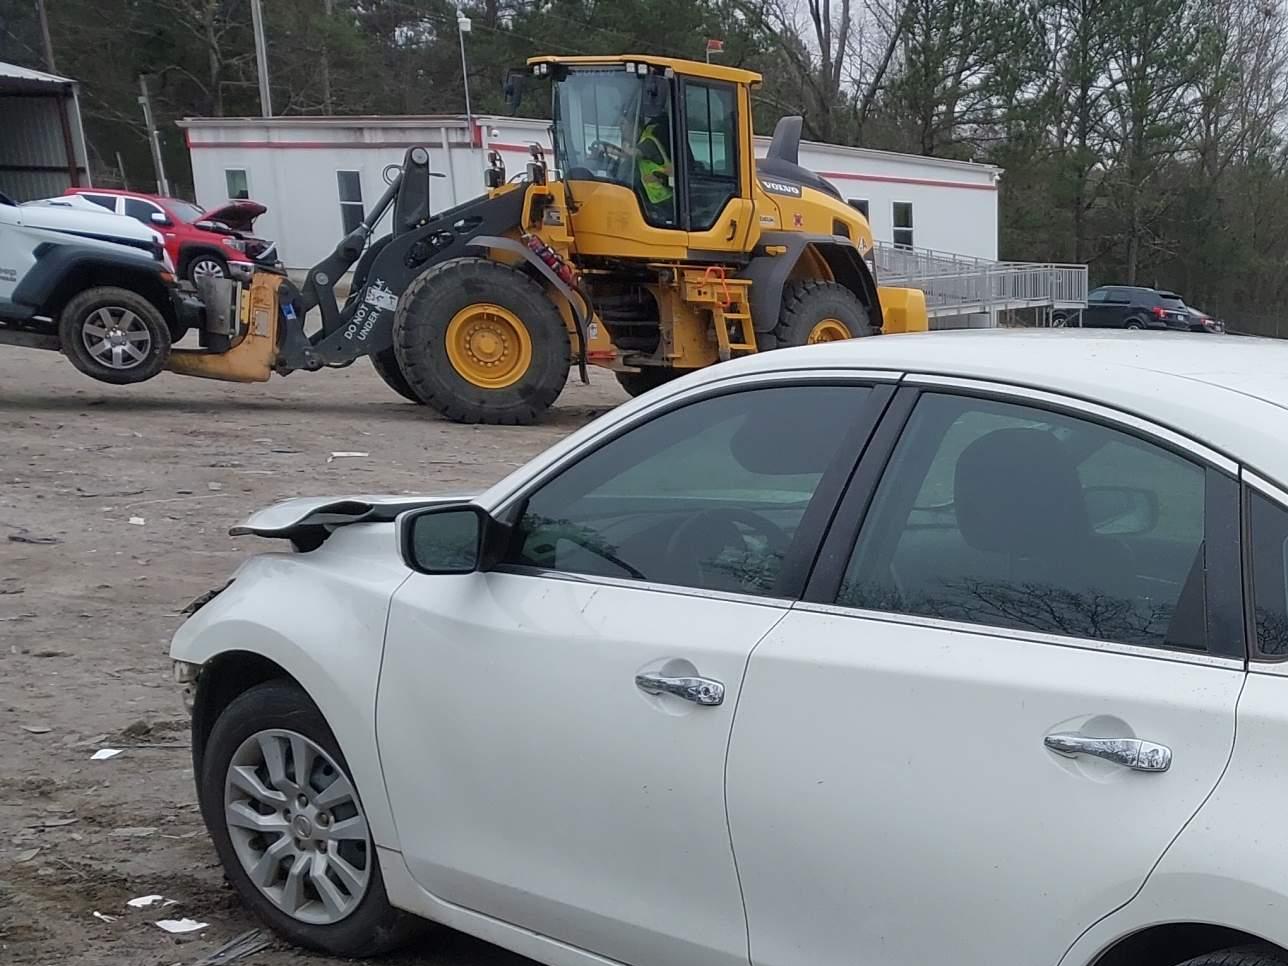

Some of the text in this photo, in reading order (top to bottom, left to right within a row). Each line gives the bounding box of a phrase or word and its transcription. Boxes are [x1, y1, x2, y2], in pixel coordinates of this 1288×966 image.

[762, 180, 799, 194] VOLVO
[344, 324, 357, 340] DO
[353, 303, 369, 325] NOT
[357, 311, 380, 341] UNDER
